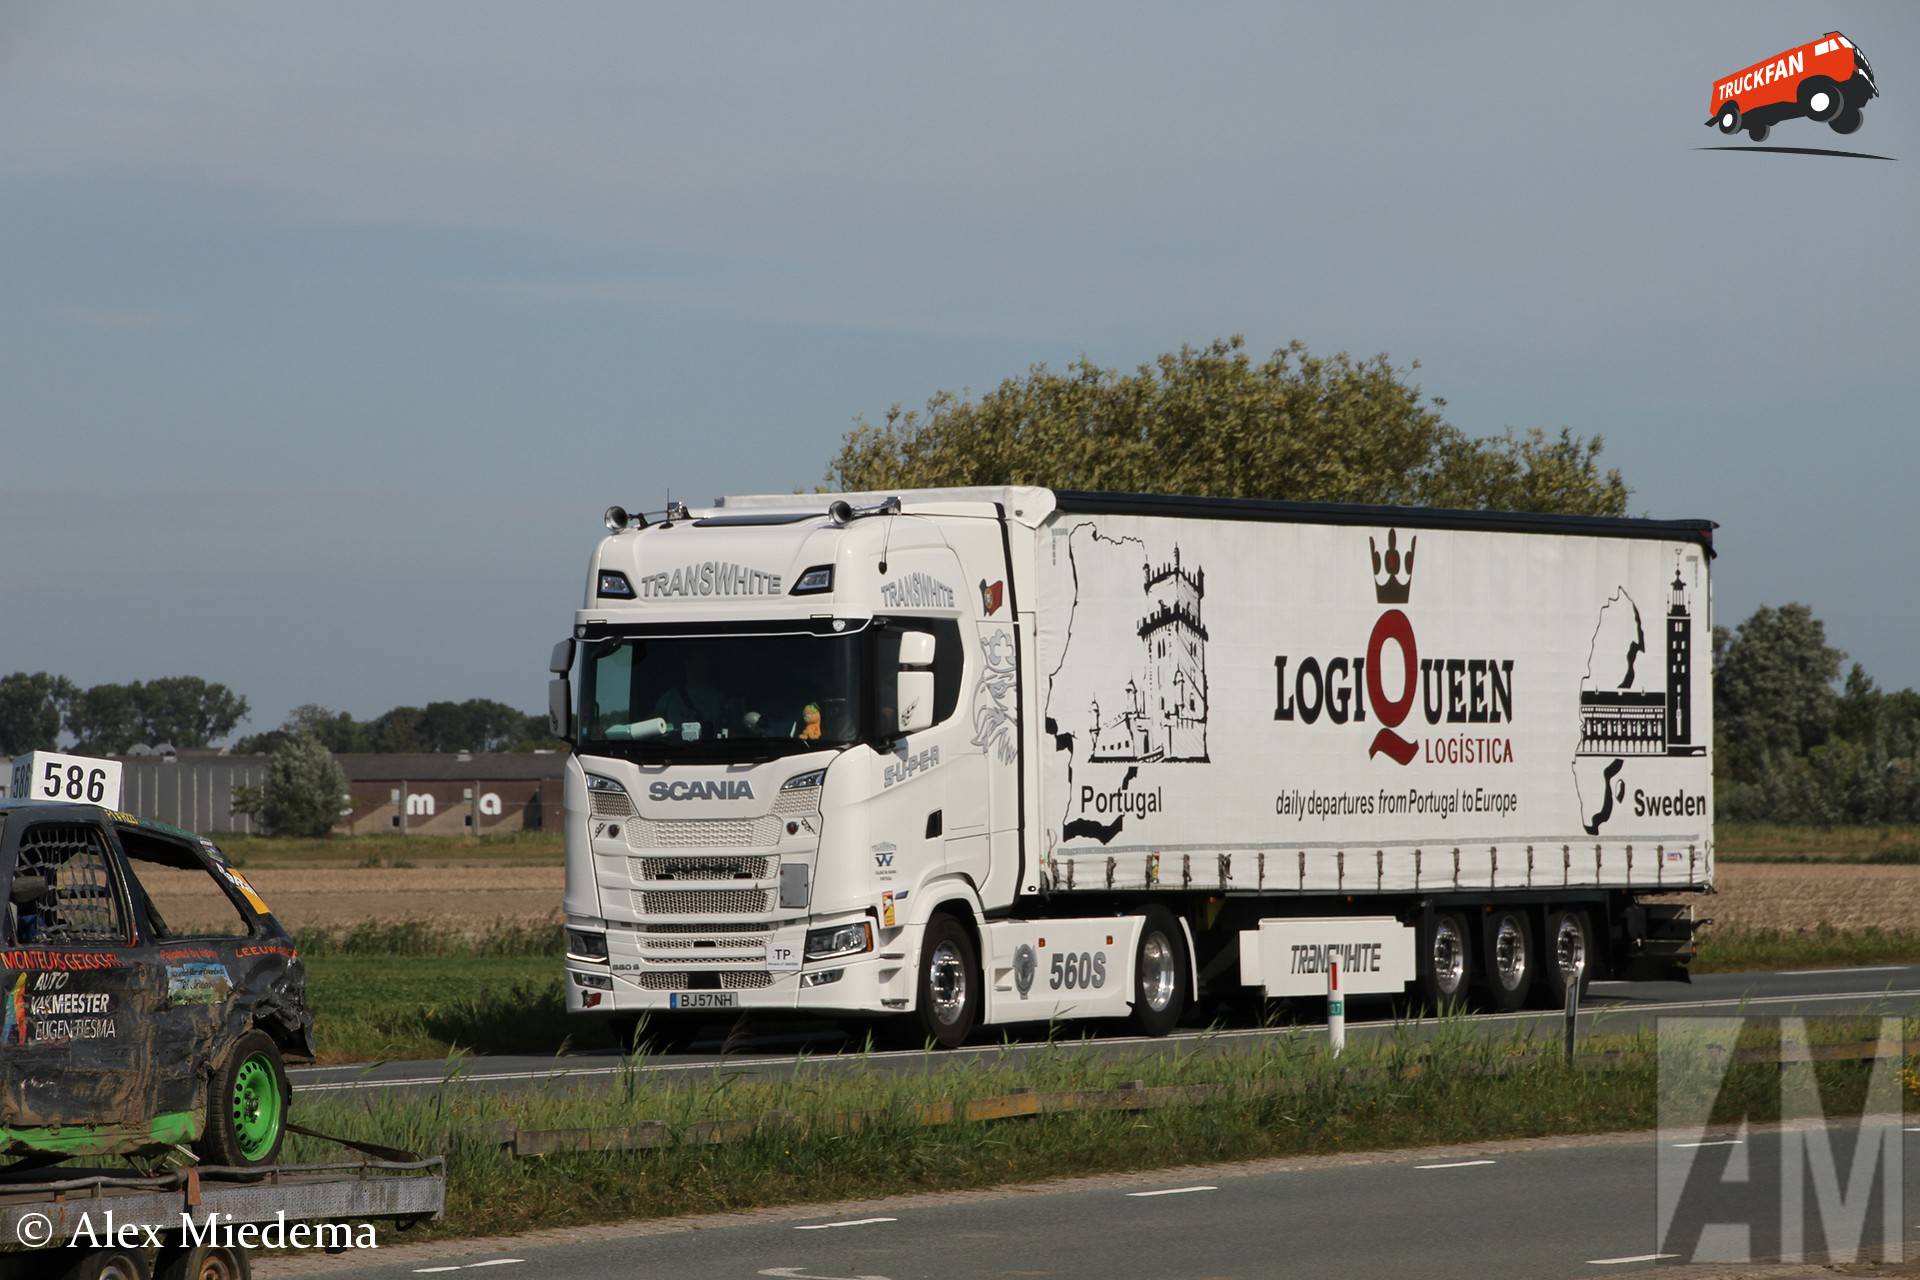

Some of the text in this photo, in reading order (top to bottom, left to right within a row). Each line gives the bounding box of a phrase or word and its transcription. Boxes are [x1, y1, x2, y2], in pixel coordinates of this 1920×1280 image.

[641, 561, 782, 598] TRANSWHITE
[880, 571, 956, 608] TRANSWHITE
[1274, 609, 1515, 766] LOGIQUEEN
[1425, 733, 1514, 764] LOGÍSTICA
[44, 762, 106, 803] 586
[884, 745, 940, 788] SUPER
[649, 780, 755, 801] SCANIA
[1081, 785, 1162, 819] Portugal
[1276, 788, 1518, 821] daily departures from Portugal to Europe
[1634, 788, 1706, 817] Sweden
[775, 949, 791, 960] TP
[1050, 952, 1106, 990] 560S
[33, 972, 70, 991] AUTO
[680, 993, 733, 1008] BJ57NH
